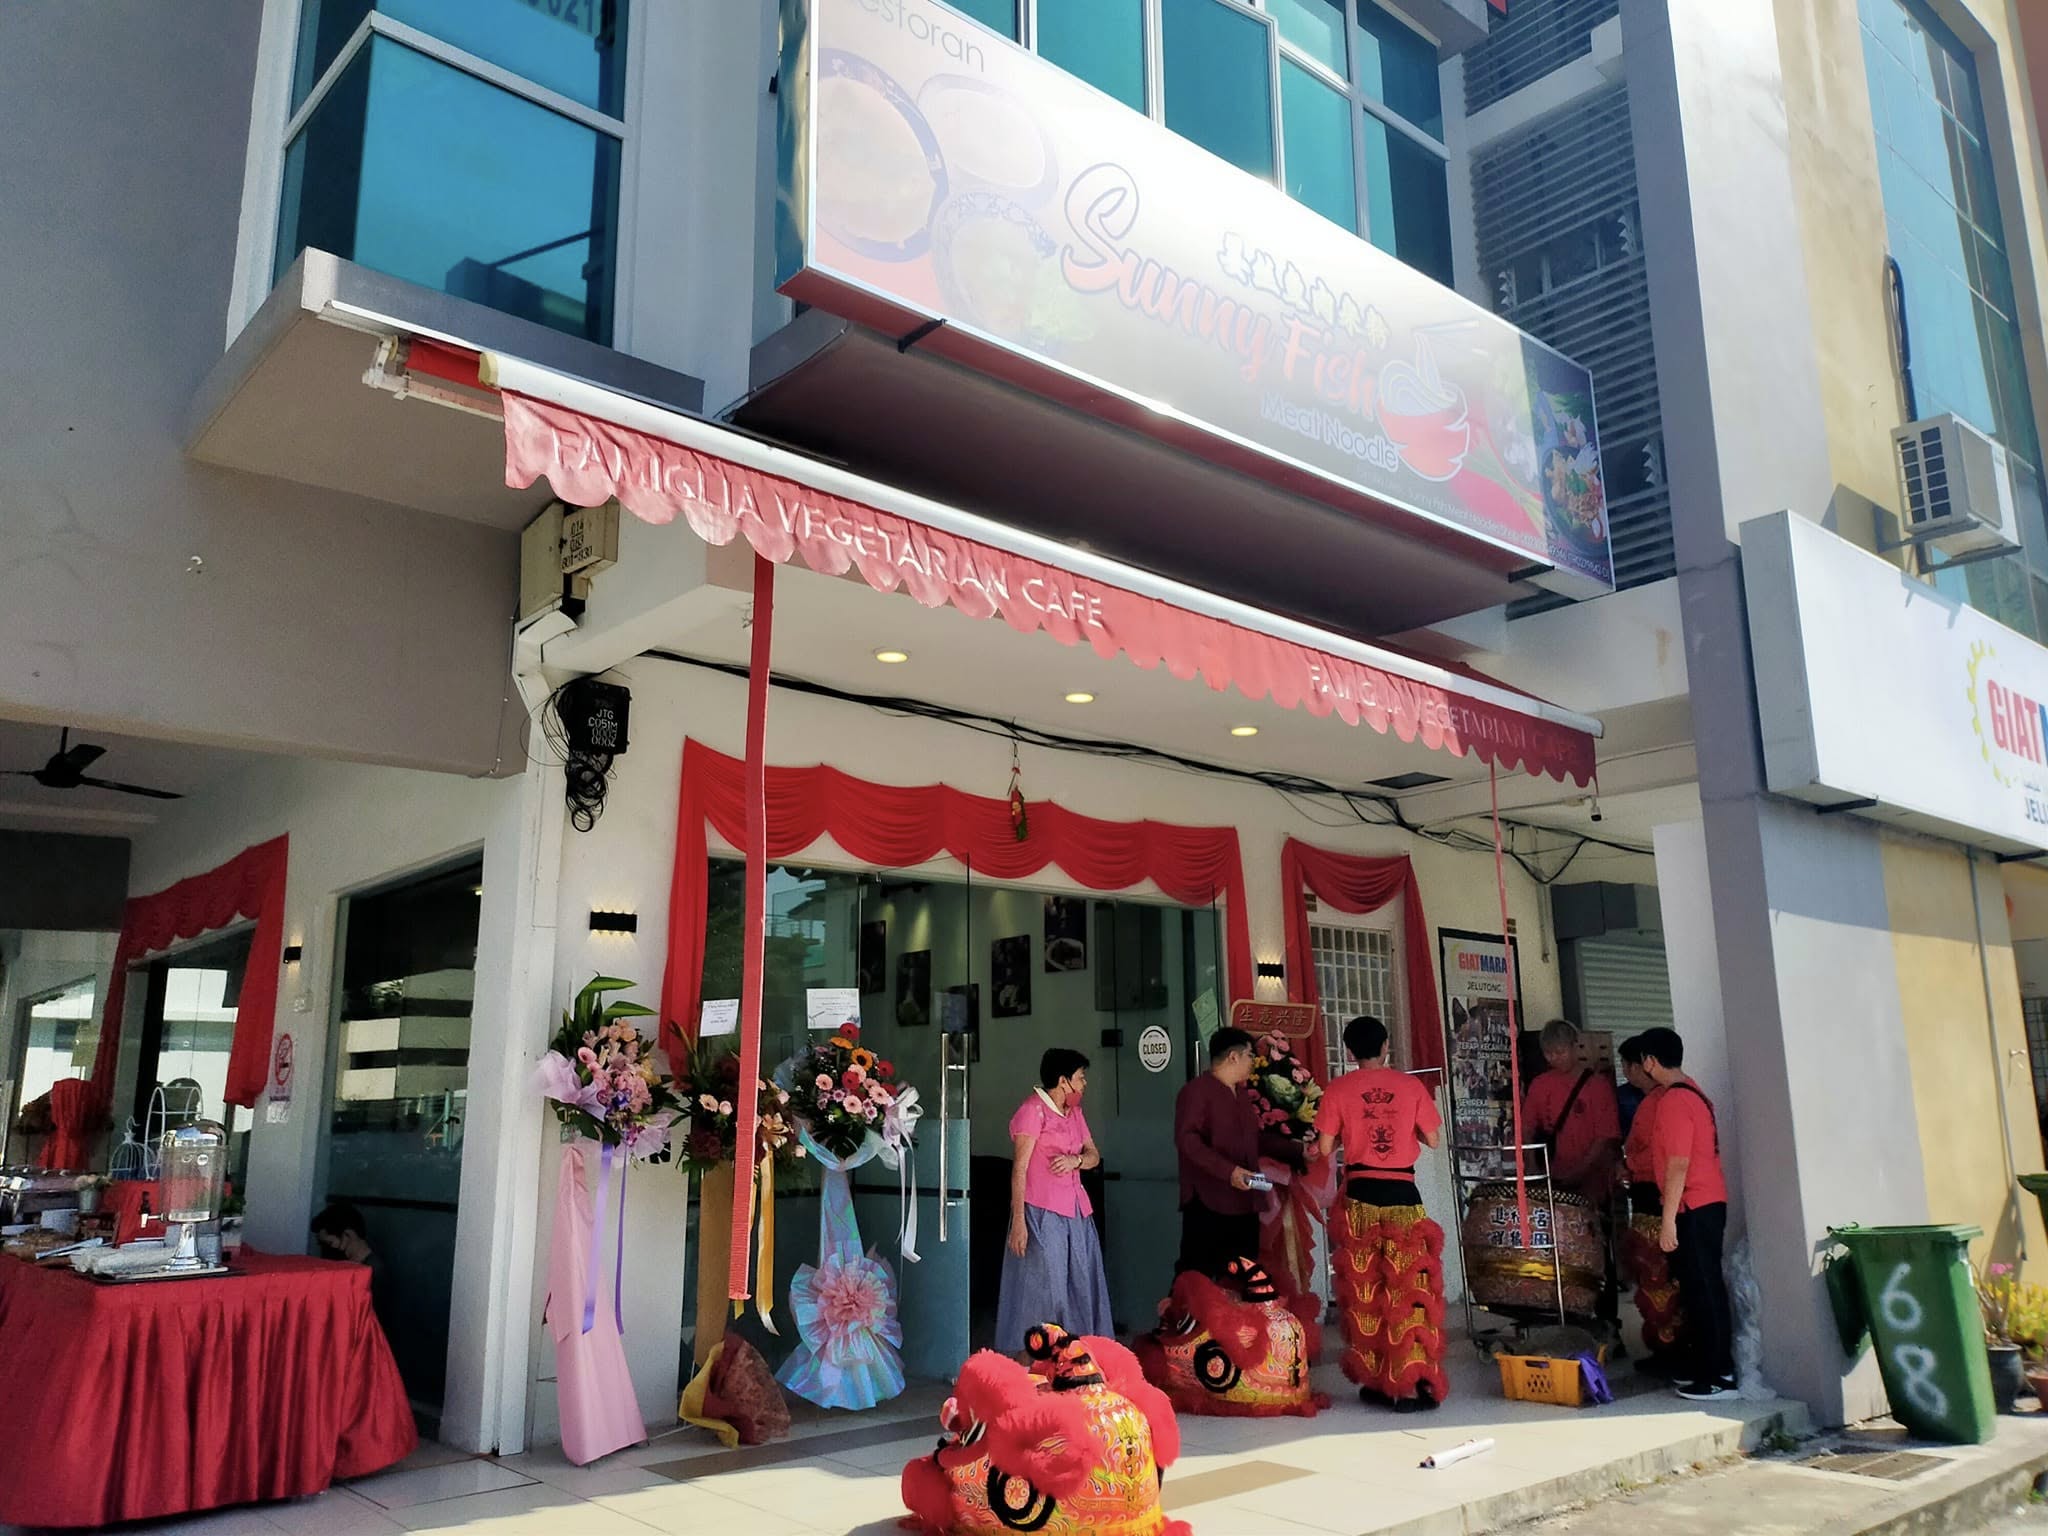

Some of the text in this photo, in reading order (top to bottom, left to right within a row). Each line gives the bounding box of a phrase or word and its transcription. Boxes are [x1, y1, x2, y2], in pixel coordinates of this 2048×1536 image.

[860, 0, 984, 73] storan
[1060, 162, 1273, 384] Sunny
[1280, 312, 1375, 418] Fish
[1262, 392, 1400, 473] Meat Noodle
[552, 427, 1105, 629] FAMIGLIA VEGETARIAN CAFE
[596, 709, 614, 720] JTG
[1988, 678, 2048, 768] GIAT
[1142, 1042, 1168, 1055] CLOSED
